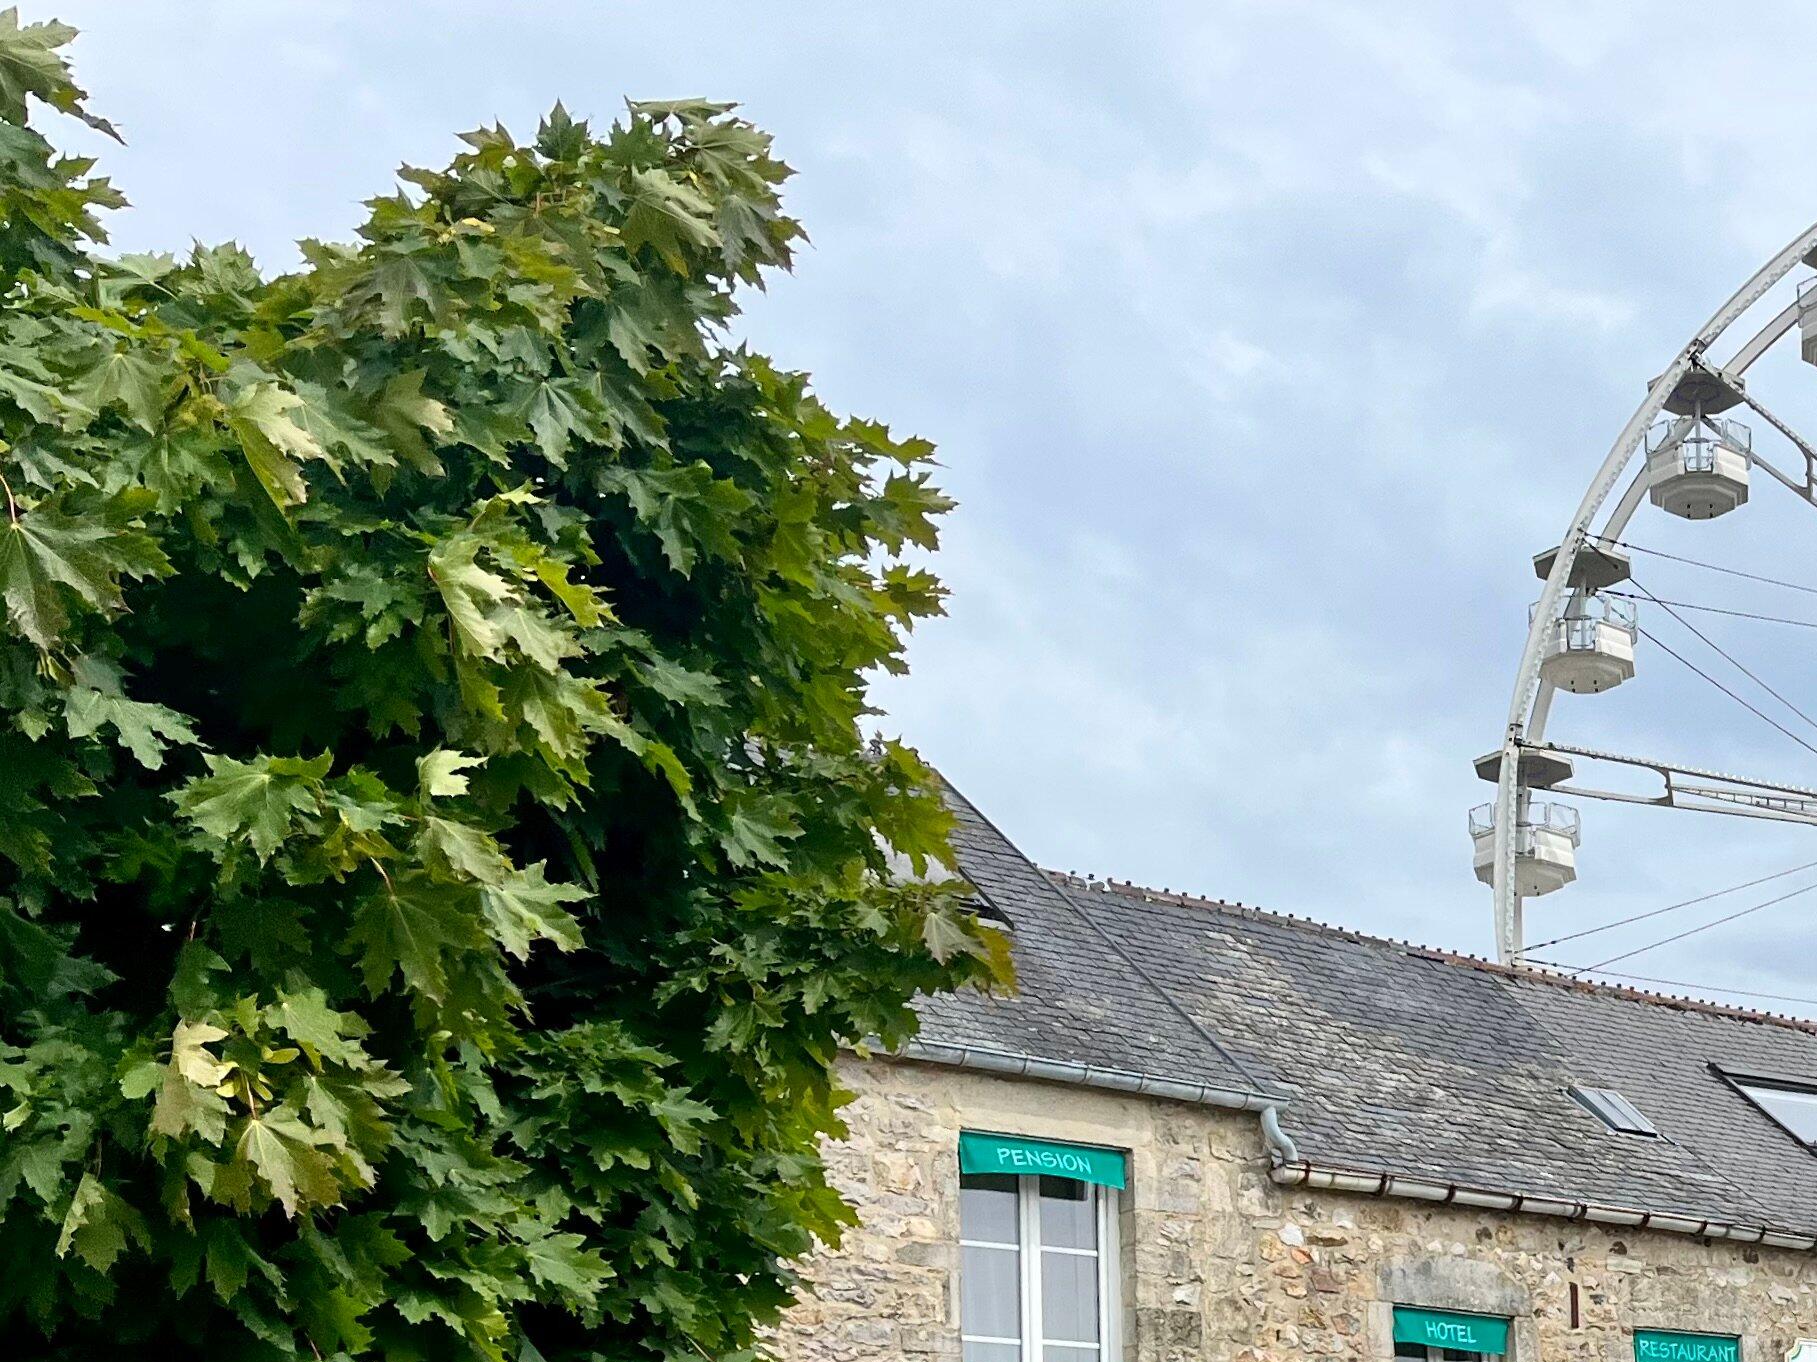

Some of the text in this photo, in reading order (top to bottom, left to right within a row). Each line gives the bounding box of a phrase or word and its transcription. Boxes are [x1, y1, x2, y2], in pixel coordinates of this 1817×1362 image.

[997, 1147, 1092, 1174] PENSION
[1424, 1321, 1477, 1344] HOTEL
[1639, 1338, 1736, 1362] RESTAURANT
